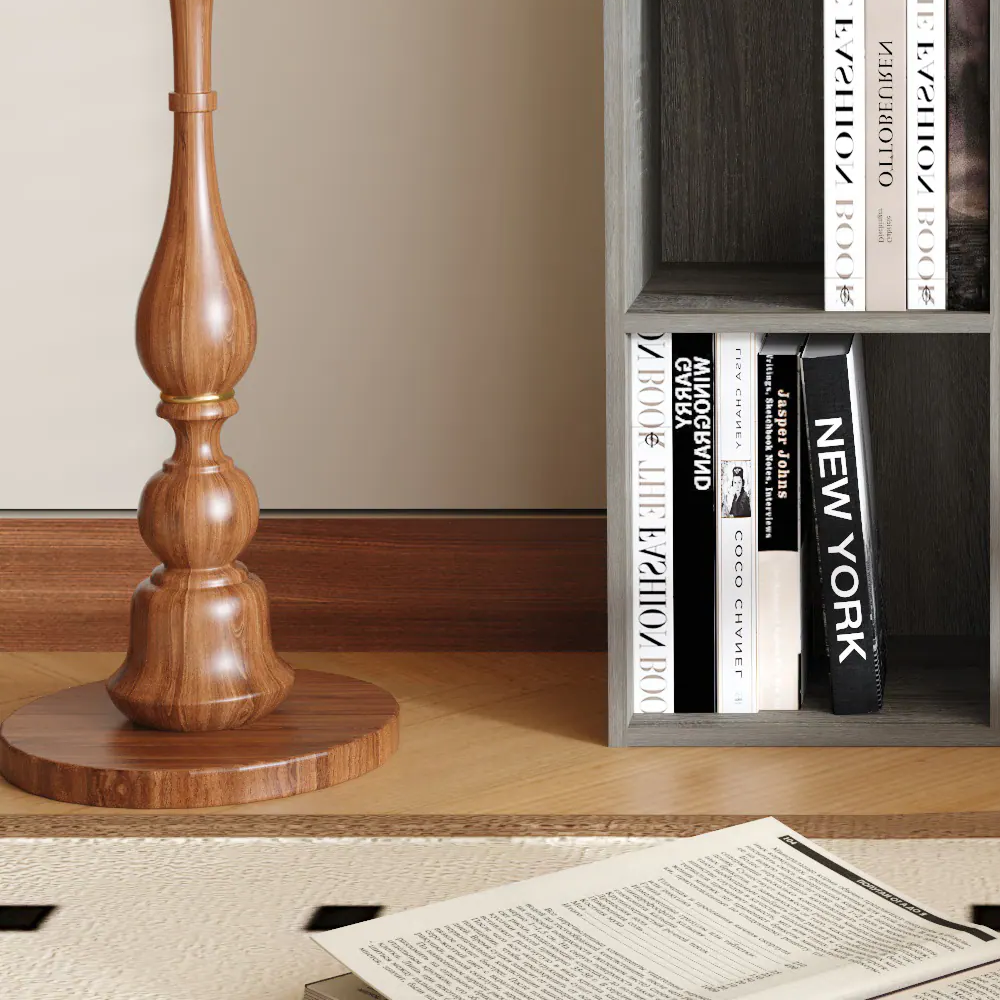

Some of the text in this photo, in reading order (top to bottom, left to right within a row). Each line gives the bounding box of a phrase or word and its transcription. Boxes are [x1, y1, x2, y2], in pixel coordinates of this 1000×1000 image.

[764, 397, 774, 452] Sketchbook
[774, 389, 790, 500] Jasper Johns
[764, 487, 774, 539] Interviews
[814, 417, 866, 664] NEW YORK
